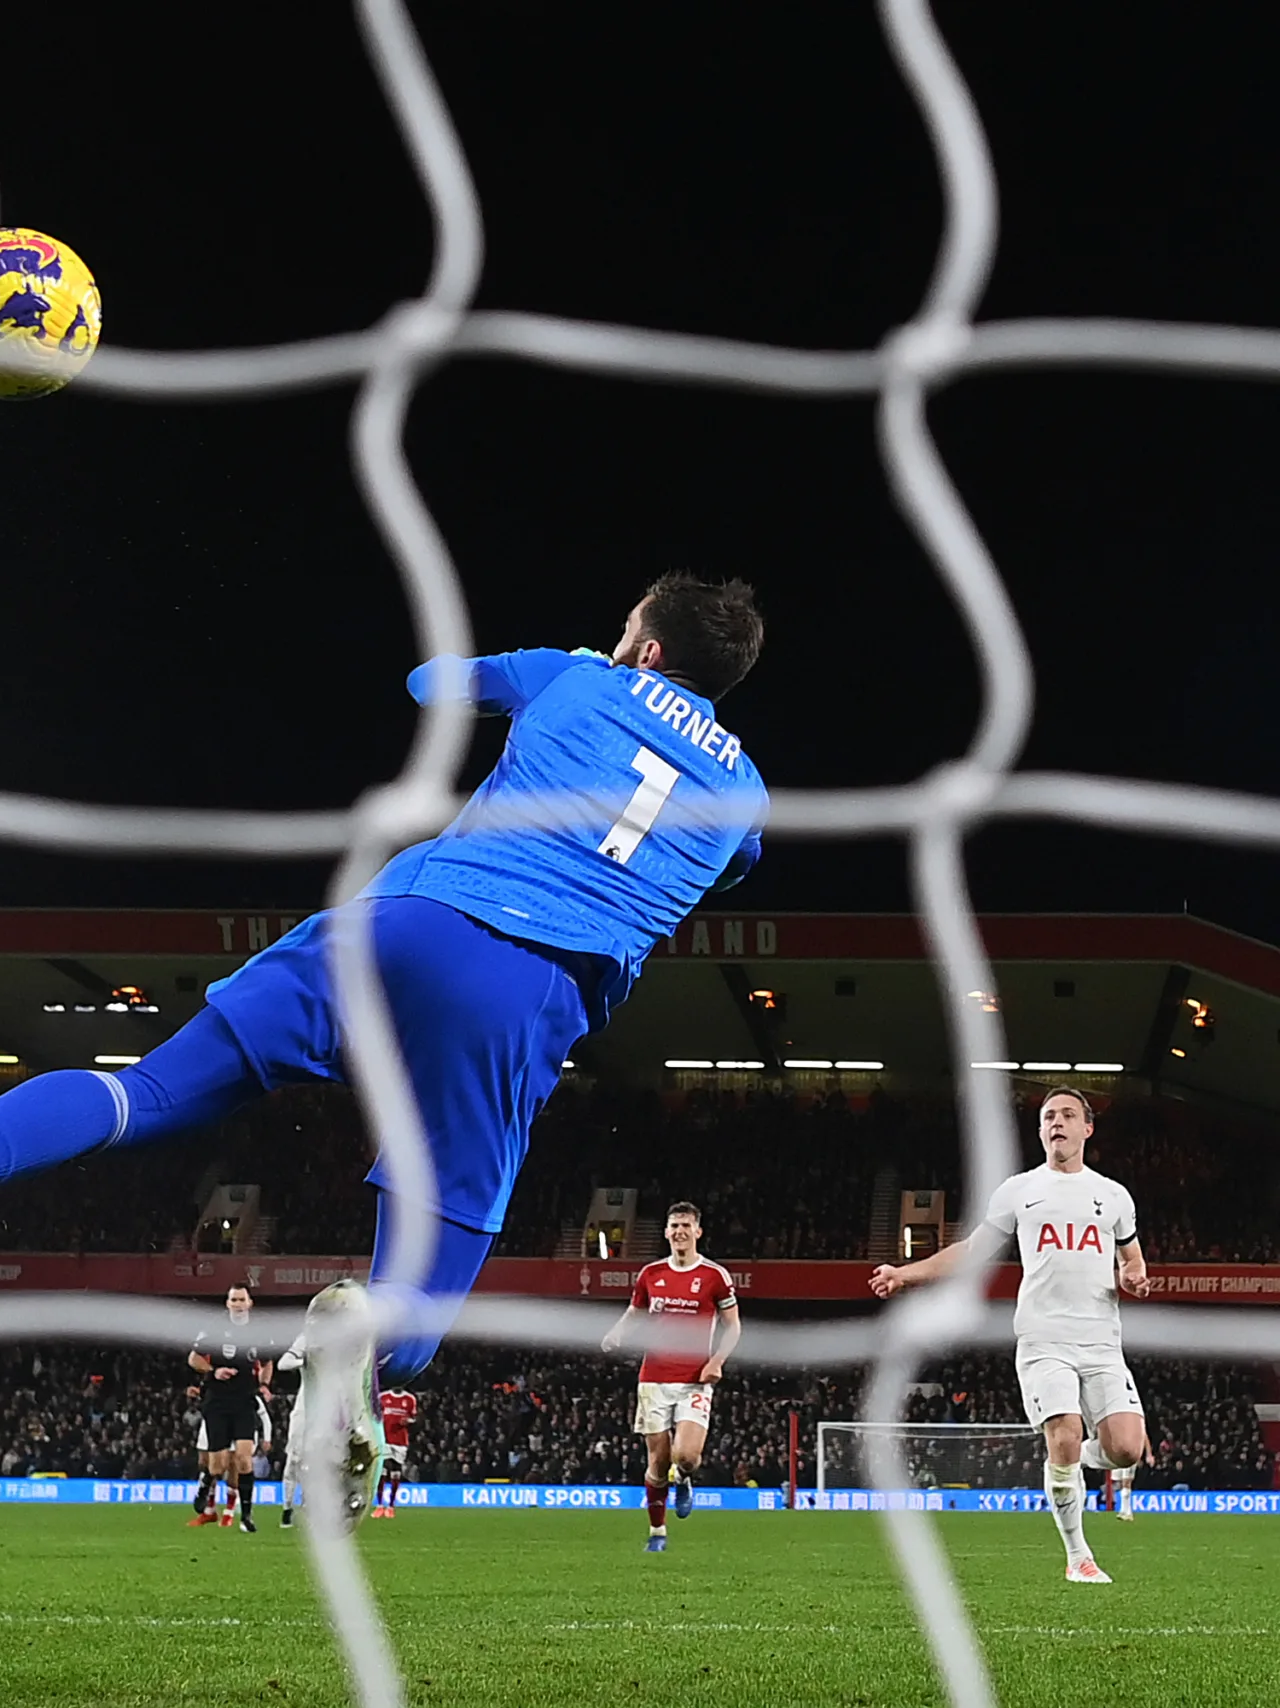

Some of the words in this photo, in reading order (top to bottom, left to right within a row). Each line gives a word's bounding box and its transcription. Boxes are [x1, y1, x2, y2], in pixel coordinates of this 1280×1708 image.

[631, 671, 742, 770] TURNER
[596, 745, 681, 865] 1
[1036, 1222, 1102, 1254] AIA
[1167, 1276, 1219, 1292] PLAYOFF
[462, 1487, 537, 1505] KAIYUN
[544, 1488, 622, 1506] SPORTS
[1132, 1494, 1208, 1511] KAIYUN
[1214, 1494, 1280, 1512] SPORT
